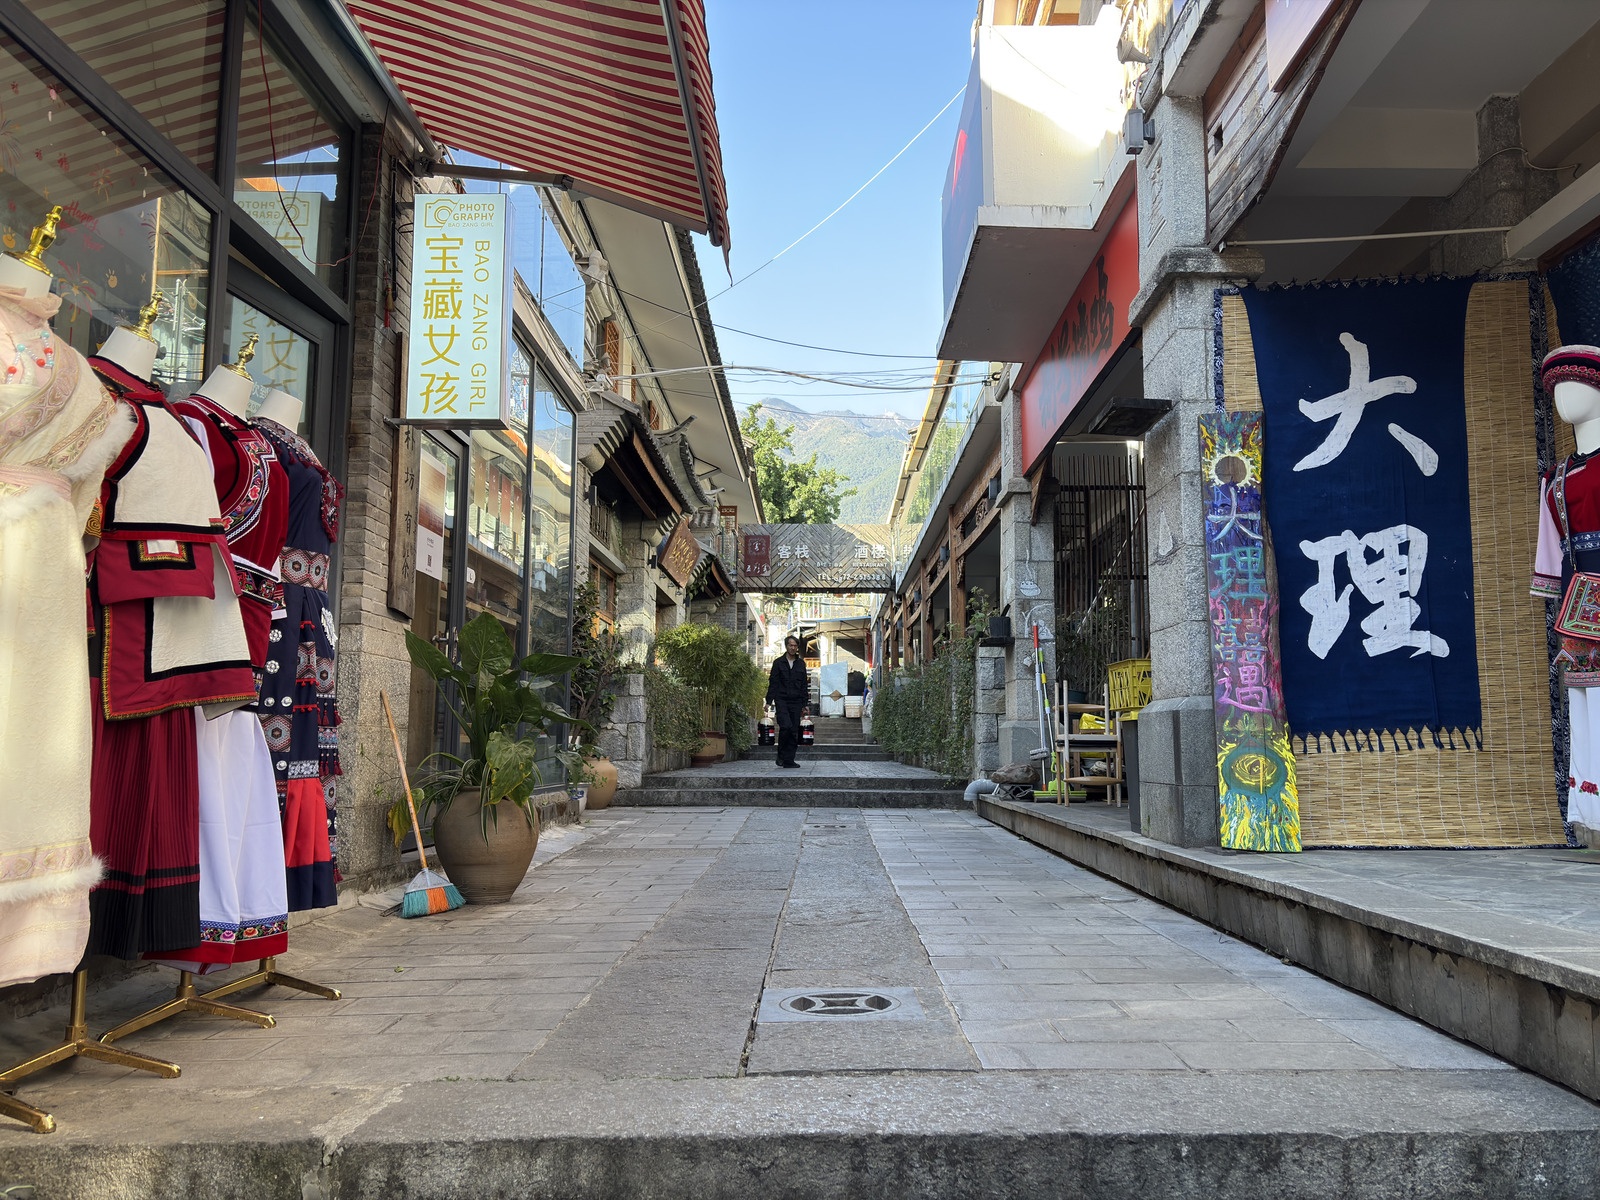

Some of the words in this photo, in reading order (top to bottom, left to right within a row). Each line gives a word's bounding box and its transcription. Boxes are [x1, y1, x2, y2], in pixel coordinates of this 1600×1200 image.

[453, 212, 495, 221] GRAPHY
[459, 203, 495, 211] PHOTO
[474, 240, 491, 283] BAO
[419, 232, 464, 415] 宝藏女孩
[471, 293, 489, 351] ZANG
[469, 363, 487, 412] GIRL
[1292, 331, 1450, 660] 大理
[777, 544, 810, 559] 客栈
[854, 544, 886, 559] 酒楼
